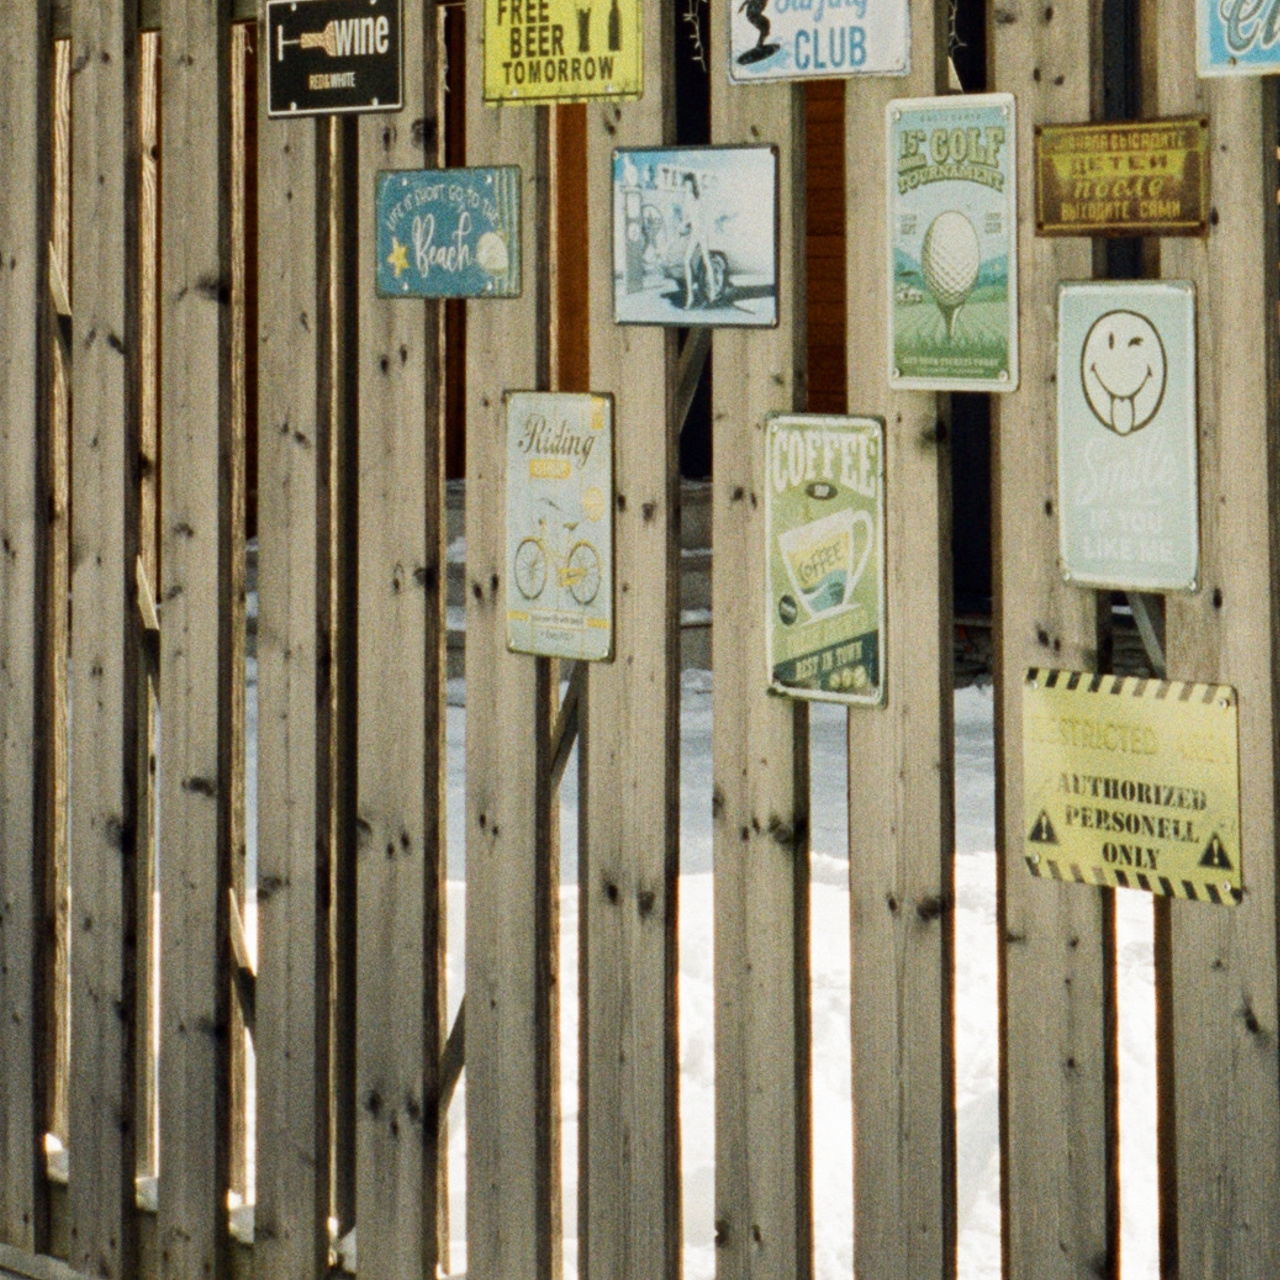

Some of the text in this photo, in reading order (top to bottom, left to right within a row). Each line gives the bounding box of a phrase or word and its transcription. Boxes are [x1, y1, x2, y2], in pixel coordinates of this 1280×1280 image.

[334, 16, 389, 56] wine
[510, 24, 565, 59] BEER
[794, 26, 867, 70] CLUB
[502, 56, 614, 85] TOMORROW
[930, 126, 1005, 168] GOLF
[898, 164, 1005, 195] TOURNAMENT
[412, 212, 472, 278] Beach
[518, 413, 596, 470] Riding
[774, 429, 876, 498] COFFEE
[1058, 773, 1207, 811] AUTHORIZED
[1065, 805, 1200, 844] PERSONELL
[1102, 842, 1160, 870] ONLY
